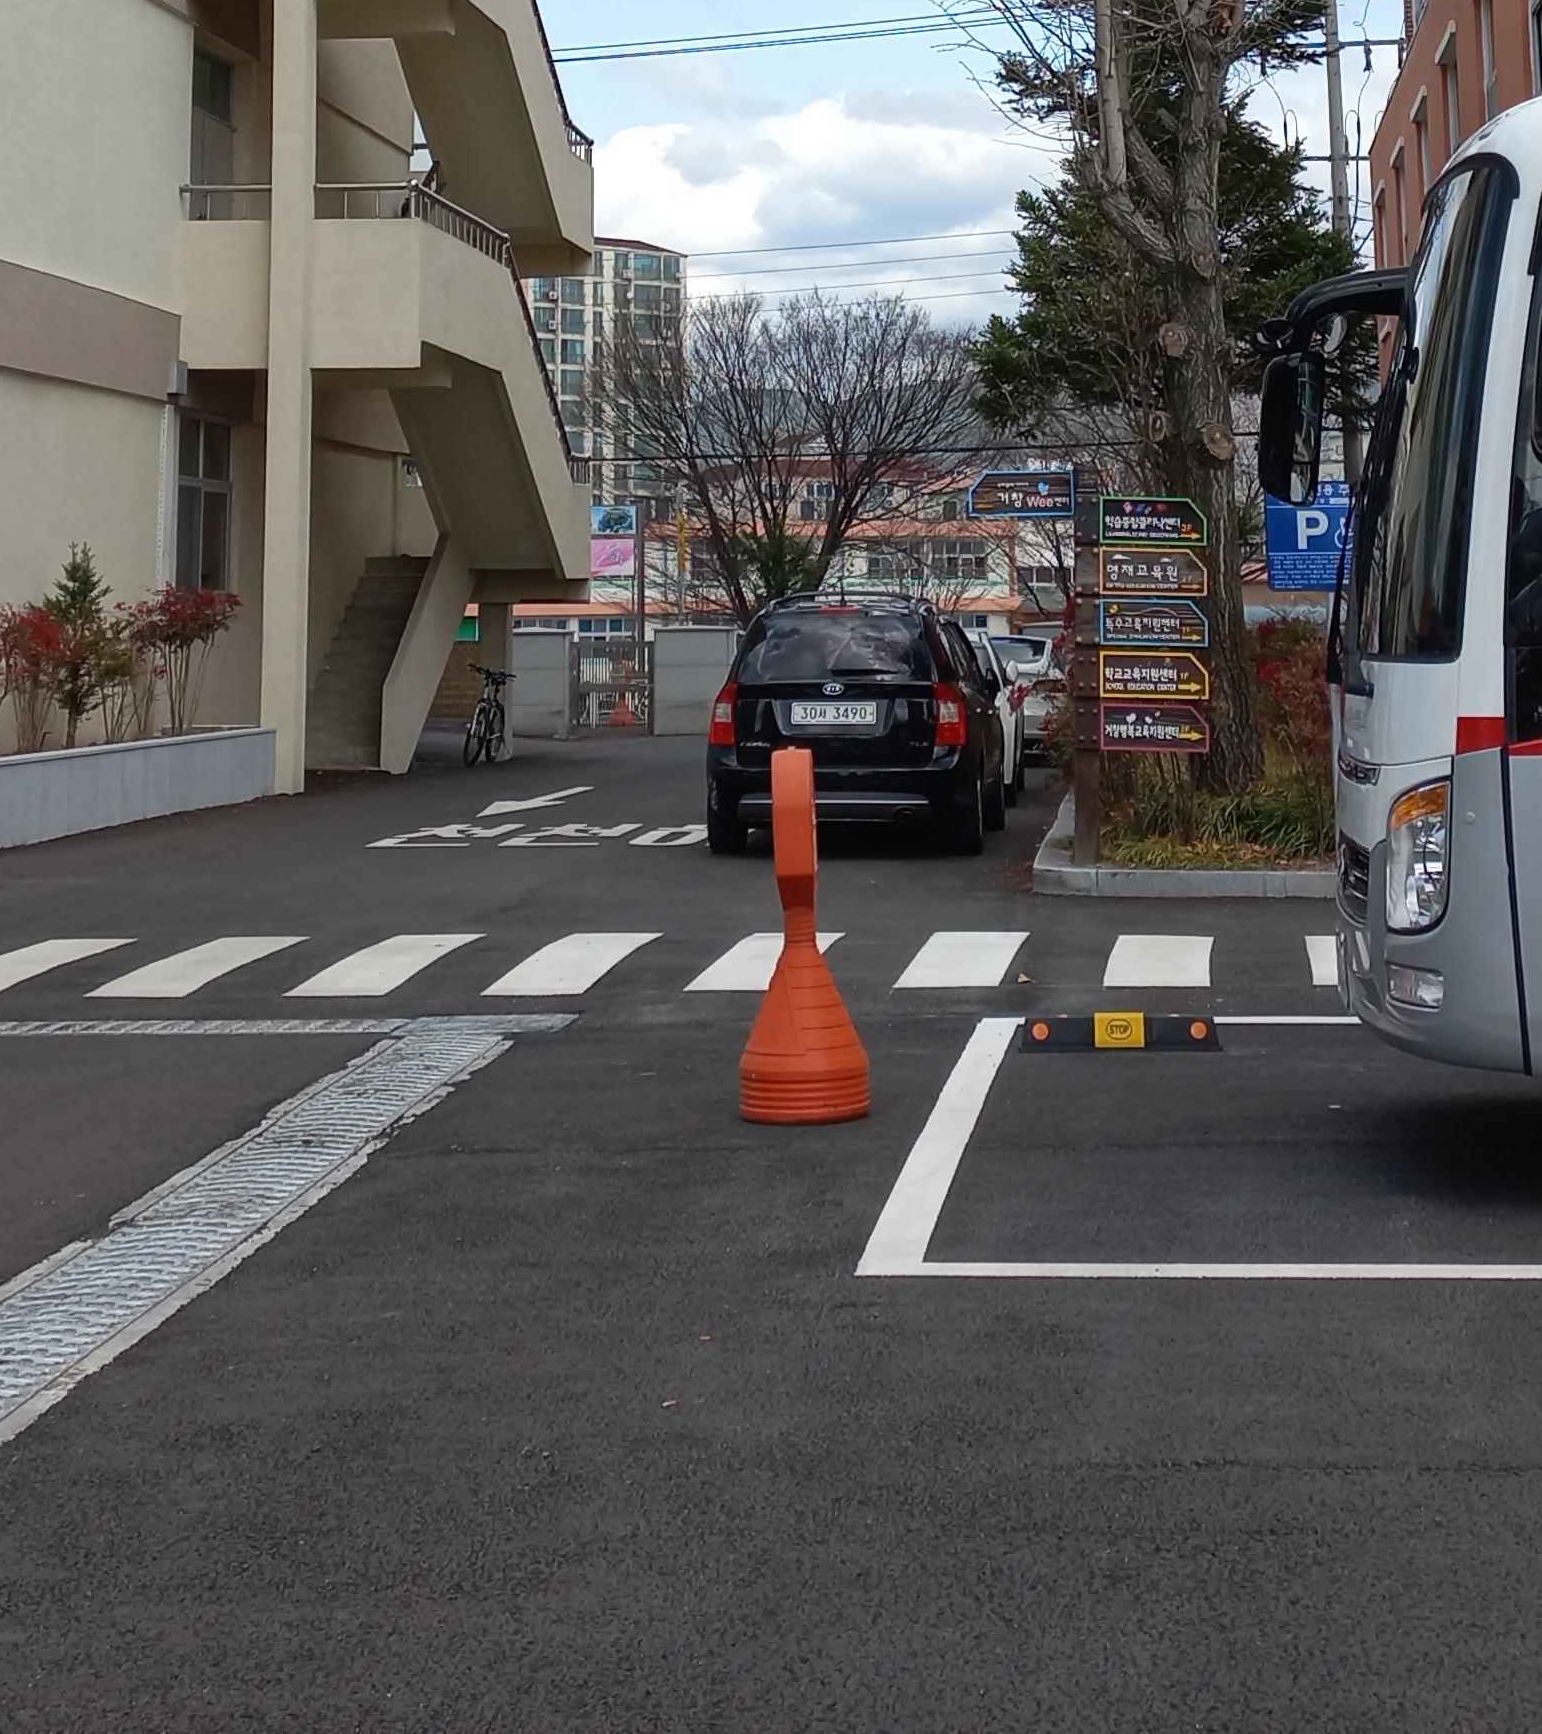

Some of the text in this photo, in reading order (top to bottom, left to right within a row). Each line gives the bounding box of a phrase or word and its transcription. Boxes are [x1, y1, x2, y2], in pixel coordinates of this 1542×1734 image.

[1297, 510, 1329, 550] P
[1106, 564, 1178, 581] 영재교육원
[1105, 617, 1180, 632] 특수교육지원센터
[833, 707, 867, 720] 3490
[1109, 1024, 1130, 1035] STOP
